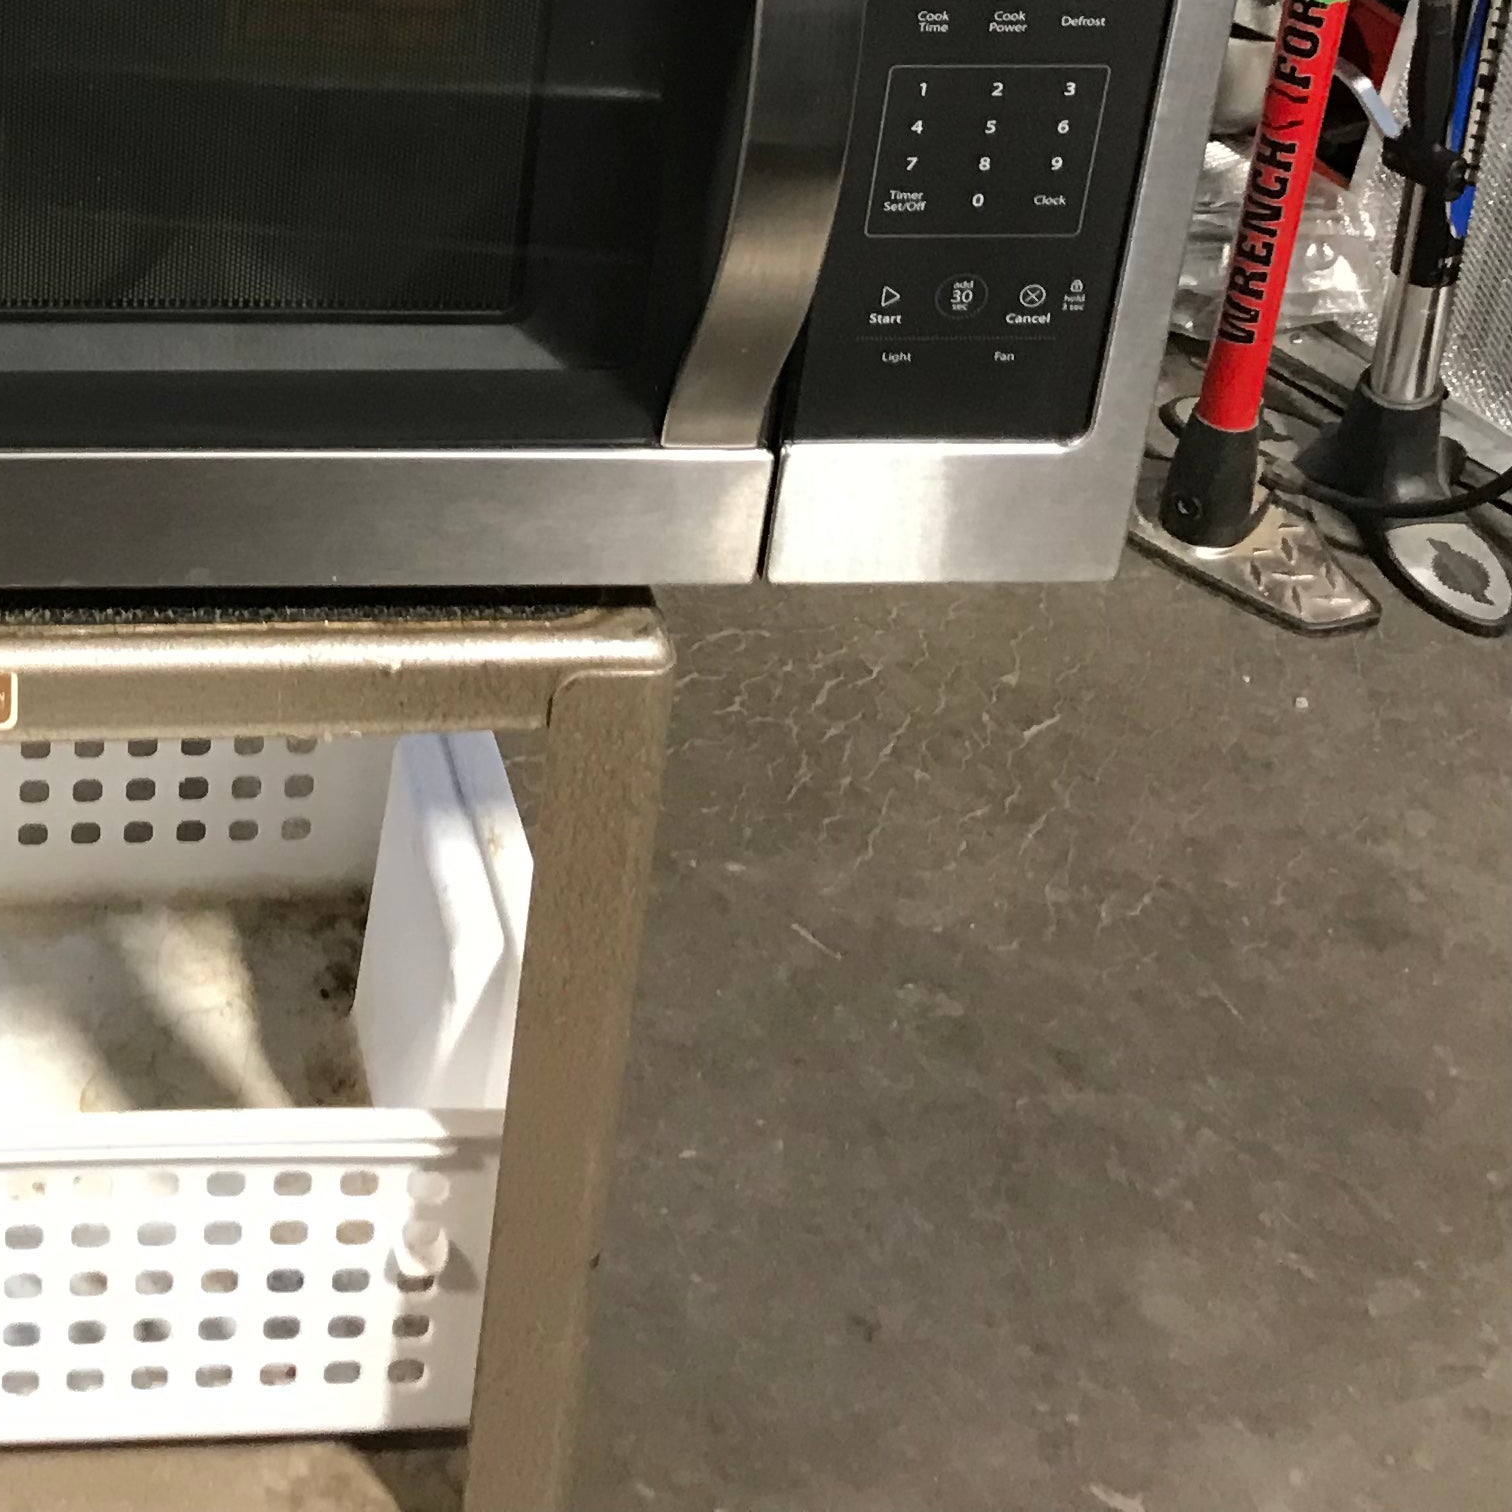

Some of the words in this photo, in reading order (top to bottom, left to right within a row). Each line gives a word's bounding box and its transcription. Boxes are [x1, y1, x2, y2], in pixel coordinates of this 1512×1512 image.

[918, 11, 949, 21] Cook
[994, 11, 1025, 21] Cook
[1061, 16, 1105, 27] Defrost
[919, 22, 948, 32] Time
[989, 22, 1027, 32] Power
[920, 82, 927, 96] 1
[992, 82, 1003, 96] 2
[1064, 82, 1076, 96] 3
[911, 120, 923, 134] 4
[985, 120, 996, 134] 5
[1057, 120, 1069, 134] 6
[907, 157, 918, 170] 7
[979, 157, 990, 171] 8
[1051, 157, 1063, 170] 9
[890, 190, 923, 201] Timer
[972, 194, 984, 207] 0
[1034, 195, 1066, 205] Clock
[884, 199, 926, 212] Set/Off
[1216, 136, 1300, 346] WRENCH
[954, 280, 974, 289] add
[951, 289, 973, 303] 30
[952, 302, 968, 310] sec
[869, 313, 901, 324] Start
[1006, 312, 1050, 324] Cancel
[882, 352, 911, 363] Light
[994, 351, 1014, 361] Fan
